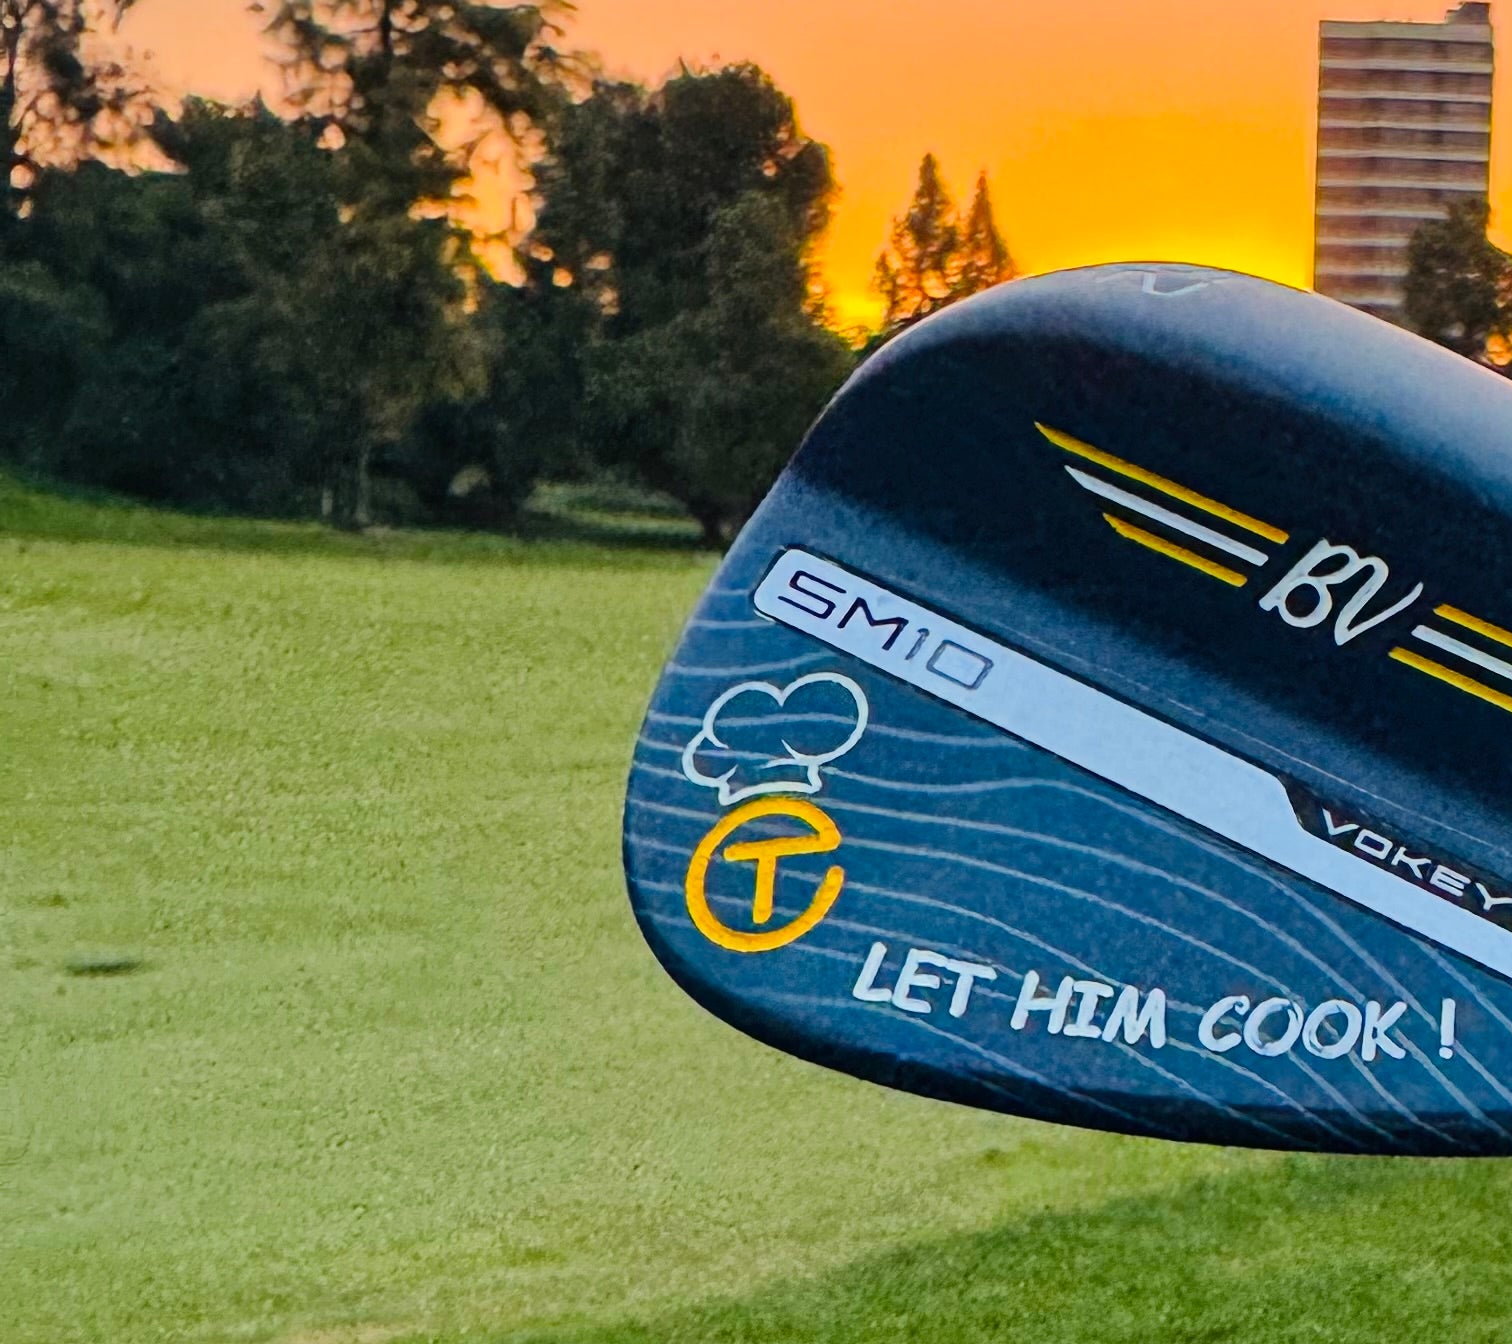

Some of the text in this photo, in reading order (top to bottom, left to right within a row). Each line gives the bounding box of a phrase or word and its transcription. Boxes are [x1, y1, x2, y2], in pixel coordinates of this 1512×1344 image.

[777, 570, 994, 691] SM10
[852, 941, 998, 1018] LET
[1010, 970, 1167, 1048] HIM
